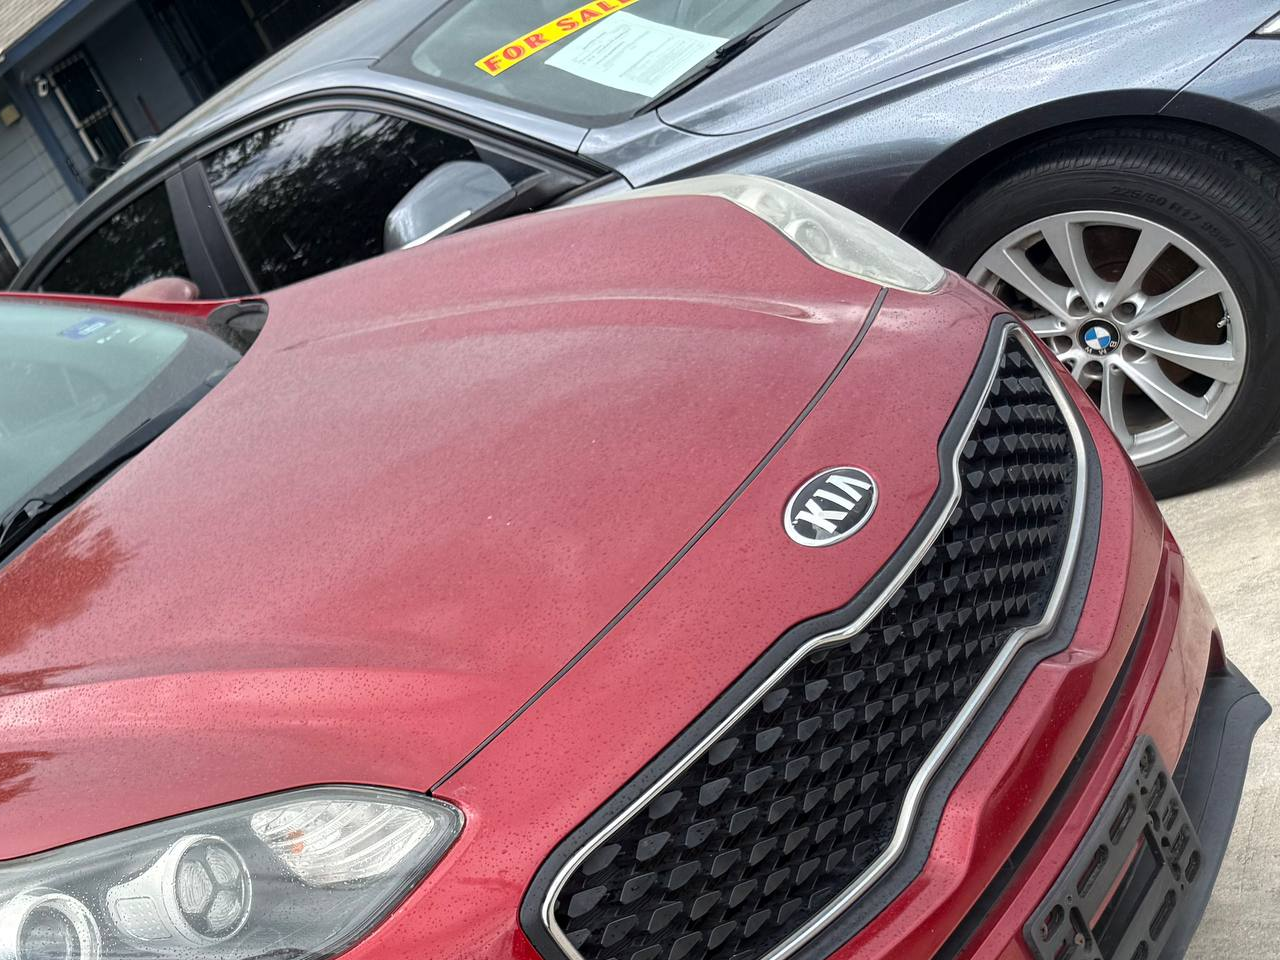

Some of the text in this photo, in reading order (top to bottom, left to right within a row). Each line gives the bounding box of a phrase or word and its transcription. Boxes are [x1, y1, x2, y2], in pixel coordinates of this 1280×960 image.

[483, 32, 551, 72] FOR
[1111, 186, 1168, 207] 225/50
[794, 471, 873, 534] KIA
